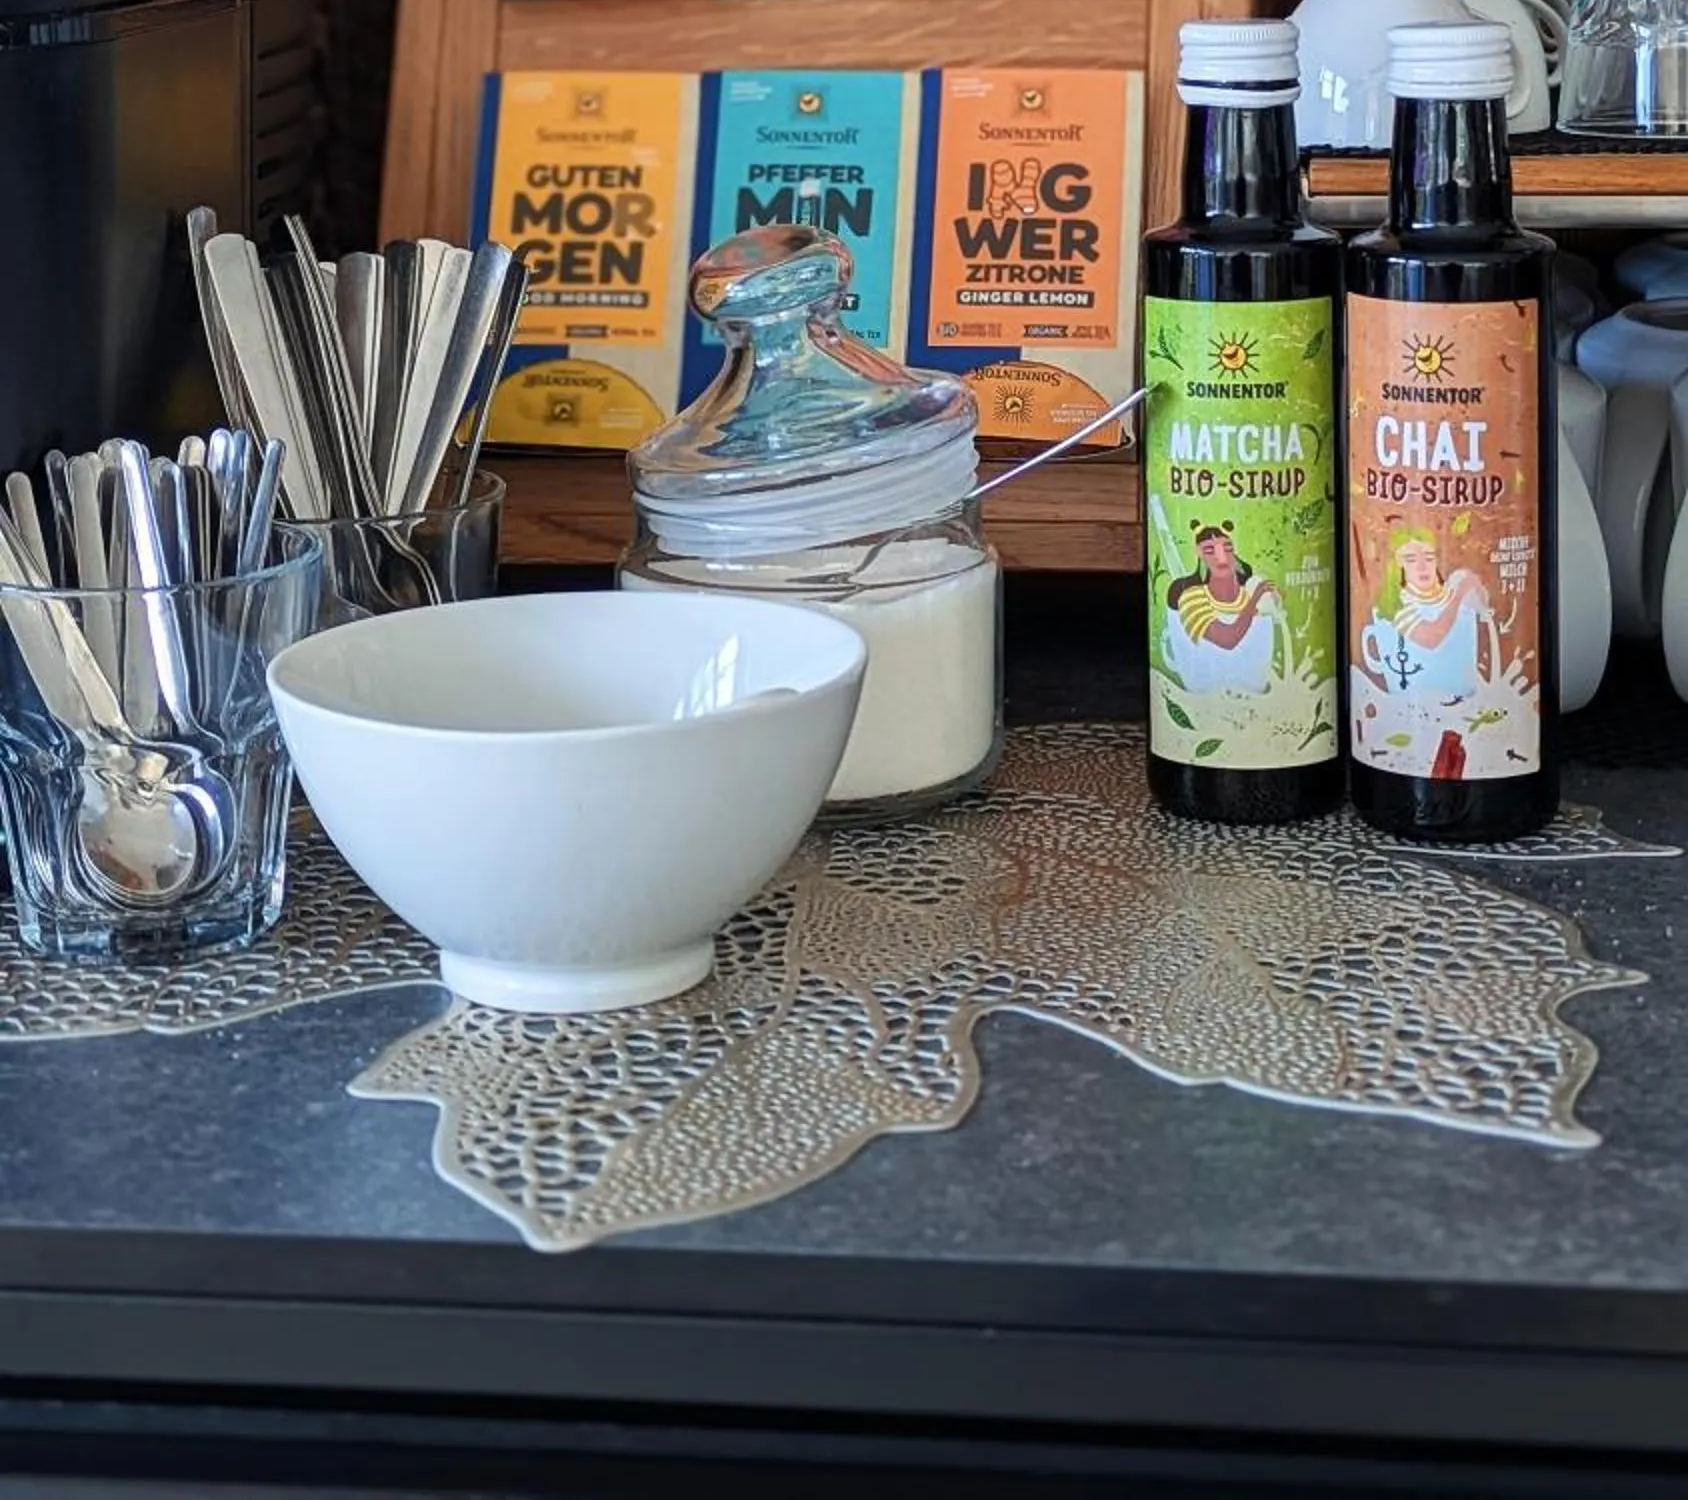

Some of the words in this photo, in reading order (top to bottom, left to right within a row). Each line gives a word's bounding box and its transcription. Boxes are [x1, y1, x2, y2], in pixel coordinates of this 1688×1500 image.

[526, 163, 643, 188] GUTEN
[748, 163, 865, 184] PFEFFER
[967, 157, 1093, 221] ING
[511, 191, 659, 238] MOR
[953, 216, 1101, 262] WER
[511, 238, 644, 285] GEN
[965, 264, 1086, 285] ZITRONE
[959, 291, 1025, 304] GINGER
[1029, 291, 1089, 305] LEMON
[1187, 382, 1286, 399] SONNENTOR
[1382, 381, 1482, 404] SONNENTOR
[1170, 420, 1304, 465] MATCHA
[1375, 414, 1488, 472] CHAI
[1170, 466, 1306, 498] BIO-SIRUP
[1366, 467, 1503, 505] BIO-SIRUP
